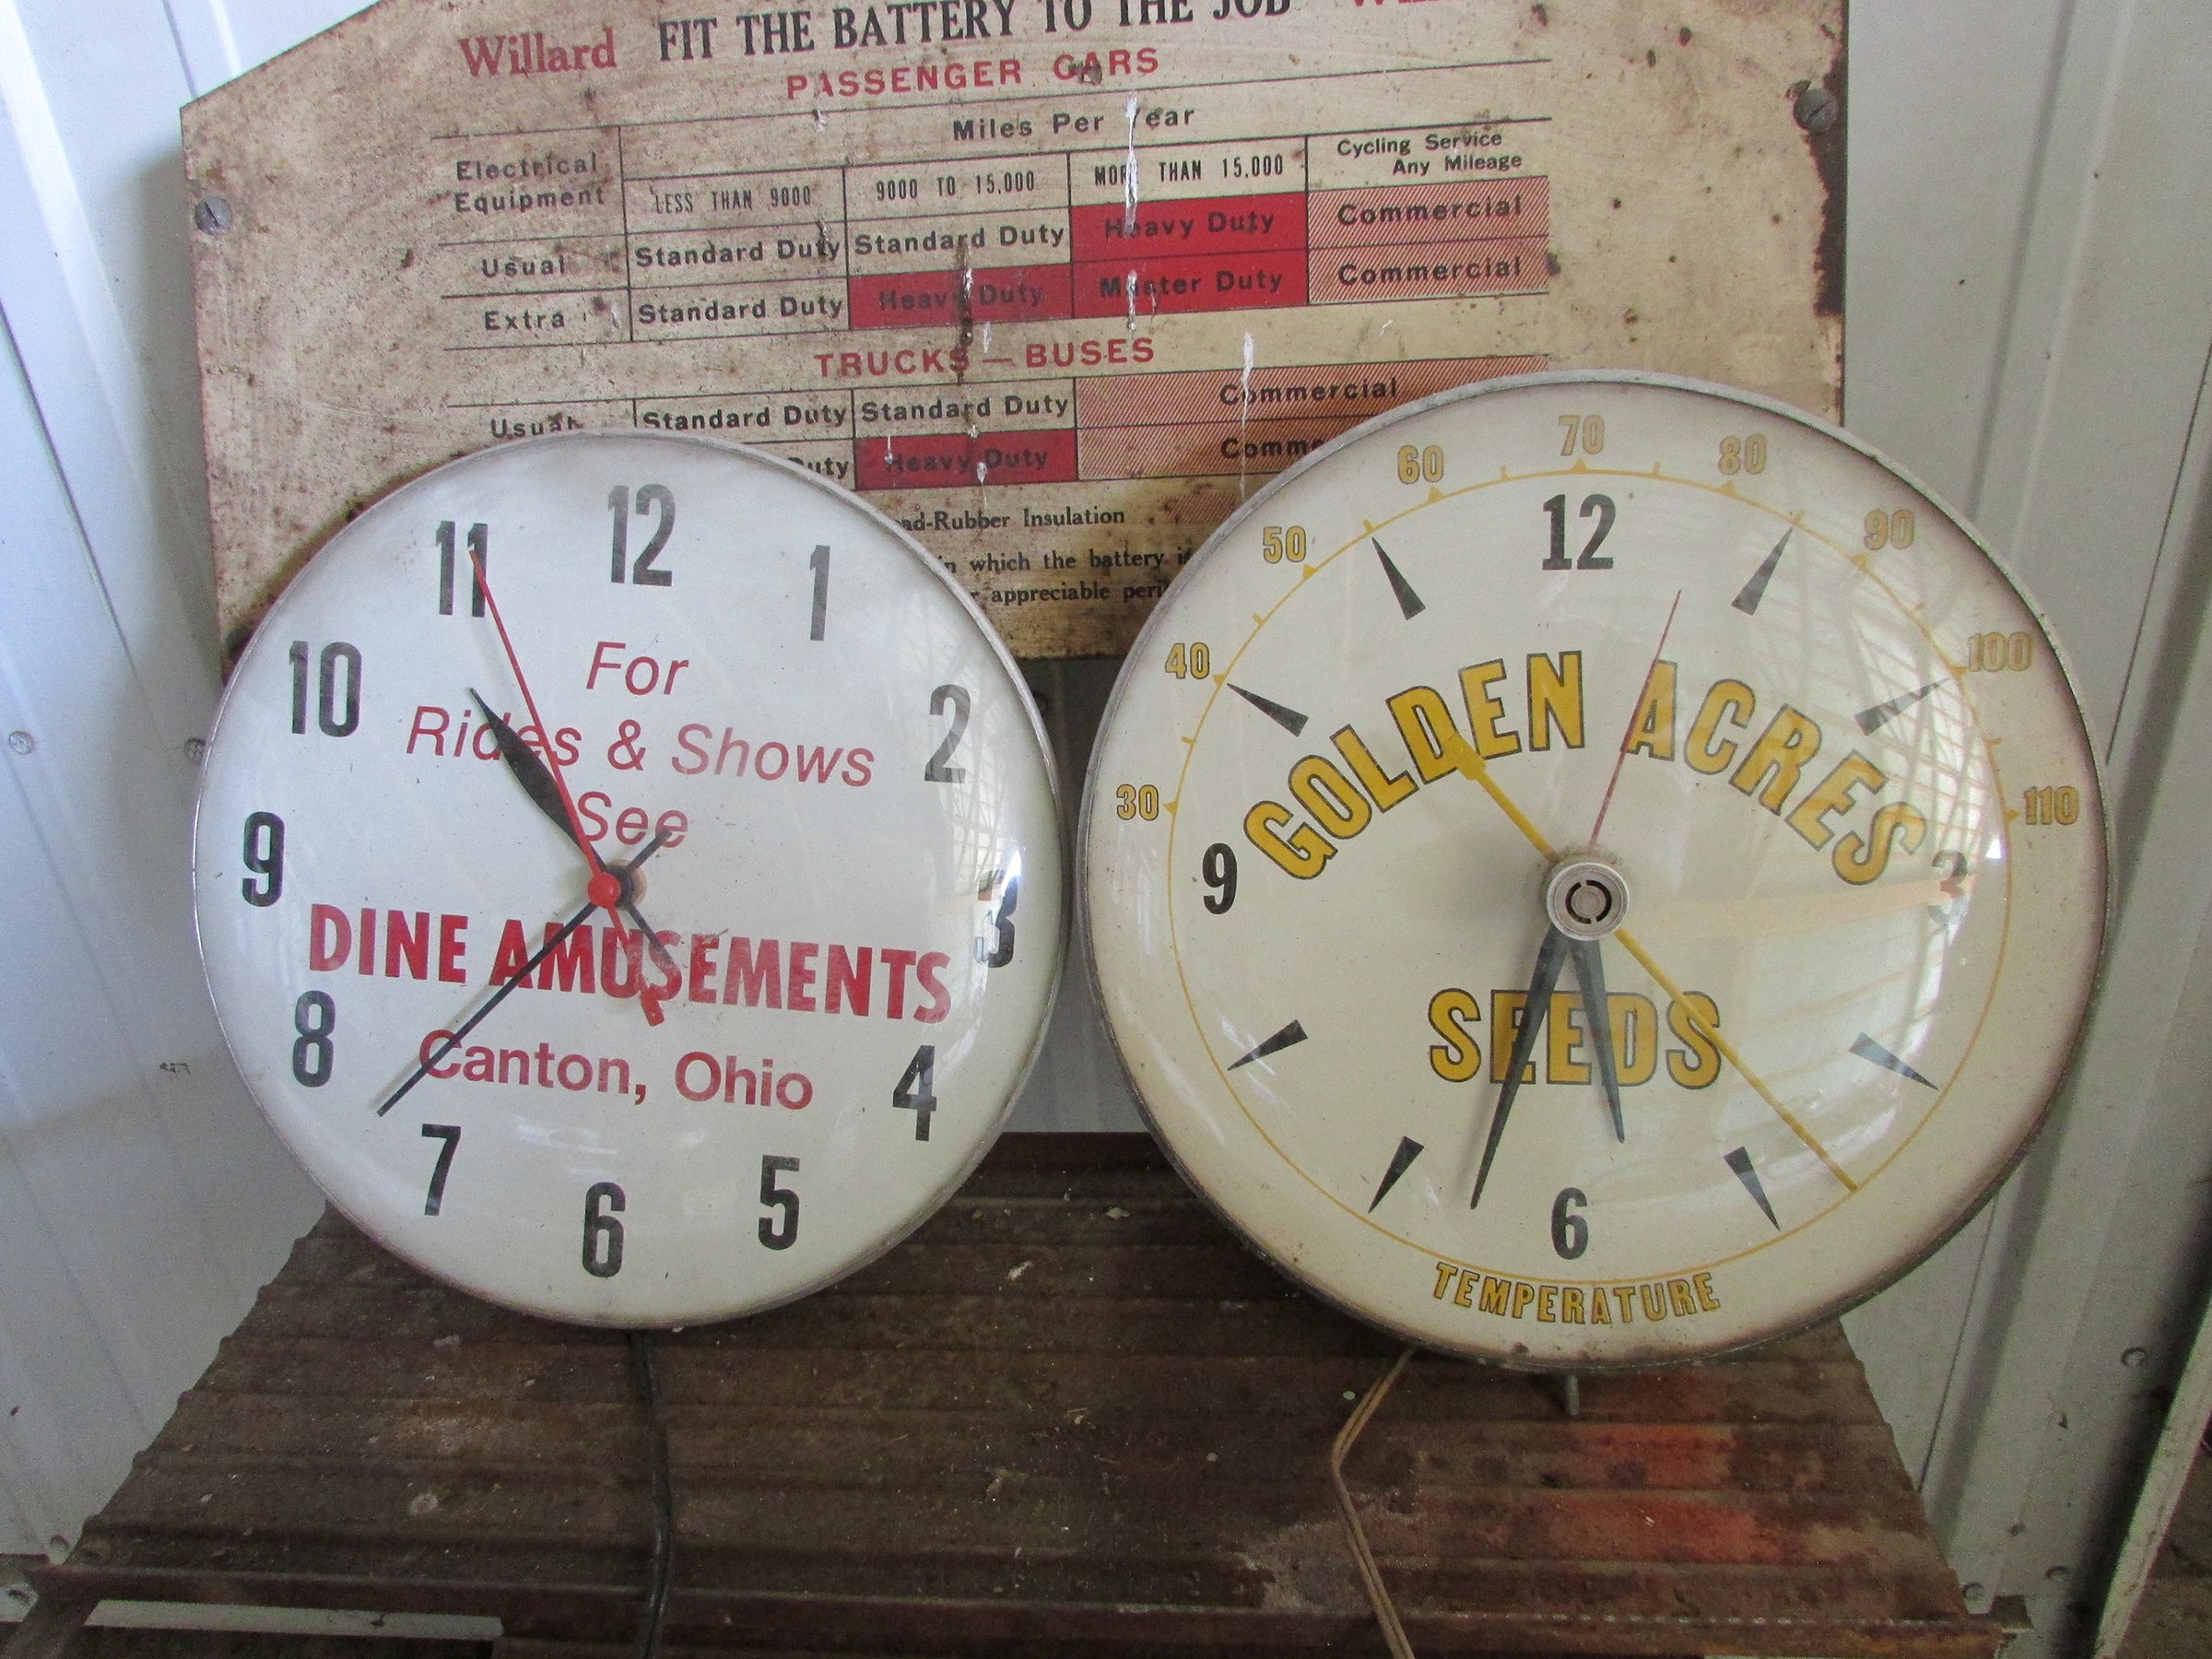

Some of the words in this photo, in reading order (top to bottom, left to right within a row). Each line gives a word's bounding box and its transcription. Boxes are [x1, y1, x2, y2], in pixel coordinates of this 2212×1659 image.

[457, 27, 618, 76] Willard
[658, 18, 717, 61] FIT
[736, 10, 815, 55] THE
[832, 0, 1015, 49] BATTERY
[786, 59, 1022, 100] PASSENGER
[1053, 47, 1159, 83] CARS
[953, 117, 1033, 141] Miles
[1052, 112, 1104, 135] Per
[1336, 137, 1411, 158] Cycling
[1425, 130, 1503, 150] Service
[455, 152, 598, 182] Electrical
[1094, 163, 1139, 186] MOR
[1159, 159, 1202, 182] THAN
[1392, 158, 1430, 176] Any
[1444, 152, 1523, 172] Mileage
[454, 186, 606, 216] Equipment
[655, 192, 694, 214] LESS
[712, 189, 753, 210] THAN
[771, 185, 812, 207] 9000
[877, 178, 919, 201] 9000
[936, 176, 957, 196] TO
[1105, 218, 1194, 239] Heavy
[1207, 210, 1275, 232] Duty
[1337, 194, 1523, 226] Commercial
[634, 241, 764, 267] Standard
[777, 239, 840, 260] Duty
[854, 228, 985, 255] Standard
[999, 224, 1065, 247] Duty
[481, 254, 566, 277] Usual
[1216, 269, 1283, 292] Duty
[1338, 255, 1523, 286] Commercial
[639, 299, 766, 324] Standard
[780, 296, 842, 319] Duty
[979, 283, 1043, 307] Duty
[484, 310, 566, 331] Extra
[814, 346, 970, 379] TRUCKS
[1026, 338, 1155, 368] BUSES
[861, 396, 991, 422] Standard
[1005, 394, 1068, 418] Duty
[1219, 377, 1398, 406] Commercial
[642, 407, 771, 430] Standard
[783, 405, 847, 428] Duty
[1558, 414, 1605, 456] 70
[983, 448, 1047, 471] Duty
[1397, 444, 1444, 485] 60
[1718, 433, 1768, 476] 80
[607, 484, 677, 587] 12
[895, 510, 1010, 531] ad-Rubber
[1023, 506, 1125, 527] Insulation
[1542, 493, 1617, 571] 12
[1863, 509, 1916, 551] 90
[970, 552, 1030, 572] which
[1043, 550, 1077, 570] the
[1089, 548, 1164, 569] battery
[1262, 525, 1307, 563] 50
[436, 521, 488, 618] 11
[809, 545, 830, 641] 1
[991, 580, 1111, 606] appreciable
[586, 641, 689, 695] For
[1165, 641, 1210, 680] 40
[1968, 630, 2034, 673] 100
[288, 641, 362, 737] 10
[406, 705, 582, 765] Rides
[607, 719, 646, 771] &
[672, 724, 876, 787] Shows
[924, 684, 971, 783] 2
[1242, 650, 1586, 880] GOLDEN
[1624, 659, 1927, 885] ACRES
[577, 791, 689, 848] See
[1116, 783, 1159, 821] 30
[2023, 785, 2079, 826] 110
[242, 811, 285, 907] 9
[1202, 842, 1238, 915] 9
[974, 869, 1019, 969] 3
[309, 903, 468, 983] DINE
[488, 918, 952, 1024] AMUSEMENTS
[292, 990, 335, 1088] 8
[1428, 987, 1722, 1089] SEEDS
[419, 1030, 647, 1105] Canton,
[675, 1051, 813, 1111] Ohio
[893, 1045, 936, 1141] 4
[422, 1124, 461, 1217] 7
[759, 1154, 800, 1251] 5
[582, 1182, 626, 1278] 6
[1551, 1187, 1589, 1260] 6
[1433, 1261, 1722, 1325] TEMPERATURE
